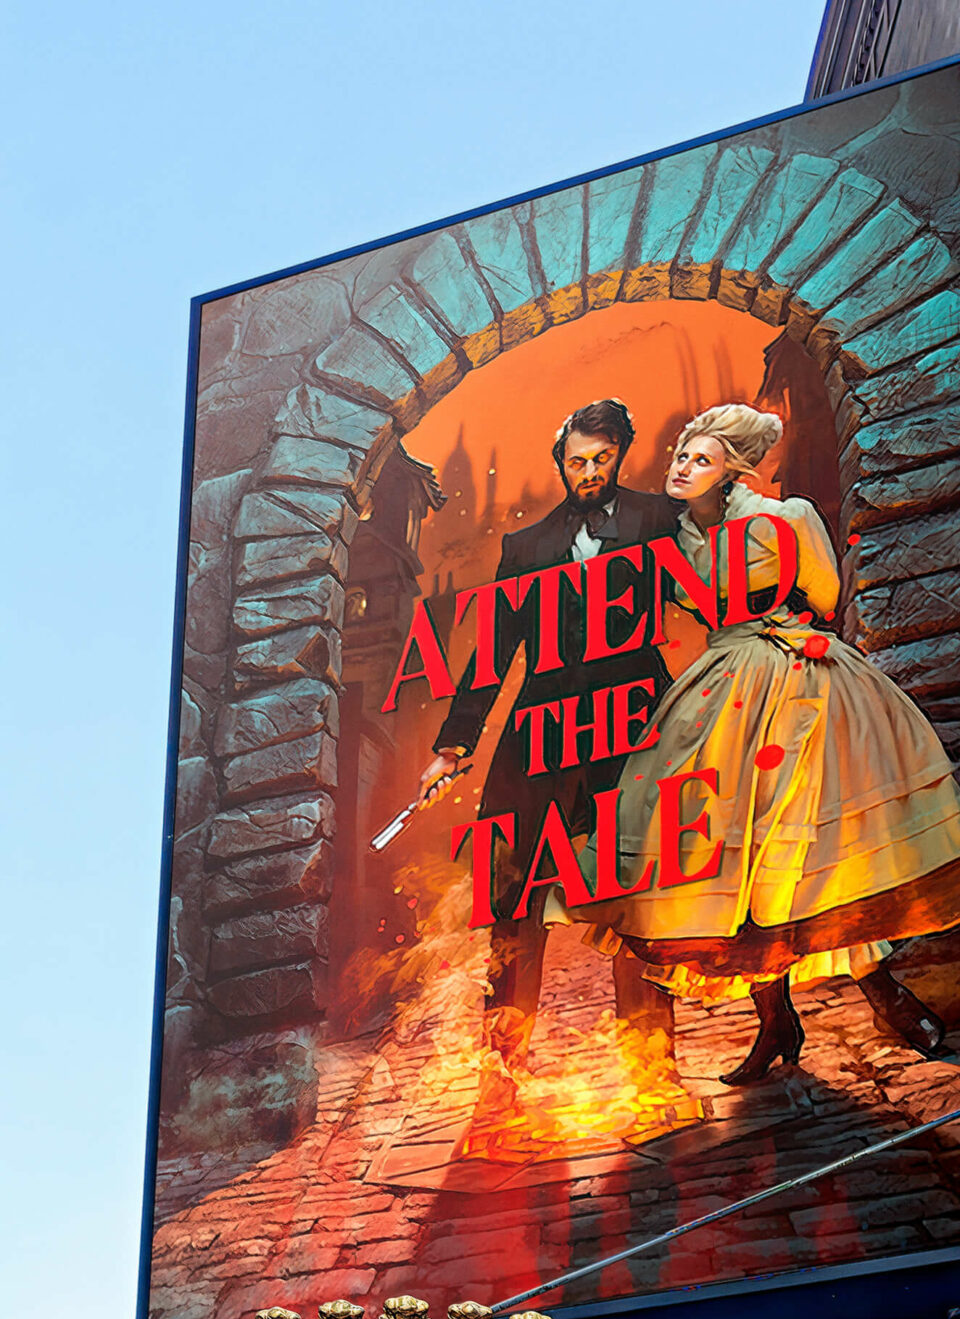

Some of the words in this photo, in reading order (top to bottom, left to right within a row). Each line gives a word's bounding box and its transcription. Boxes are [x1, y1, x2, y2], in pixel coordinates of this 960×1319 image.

[381, 512, 798, 713] ATTEND
[514, 677, 661, 777] THE
[450, 767, 724, 929] TALE
